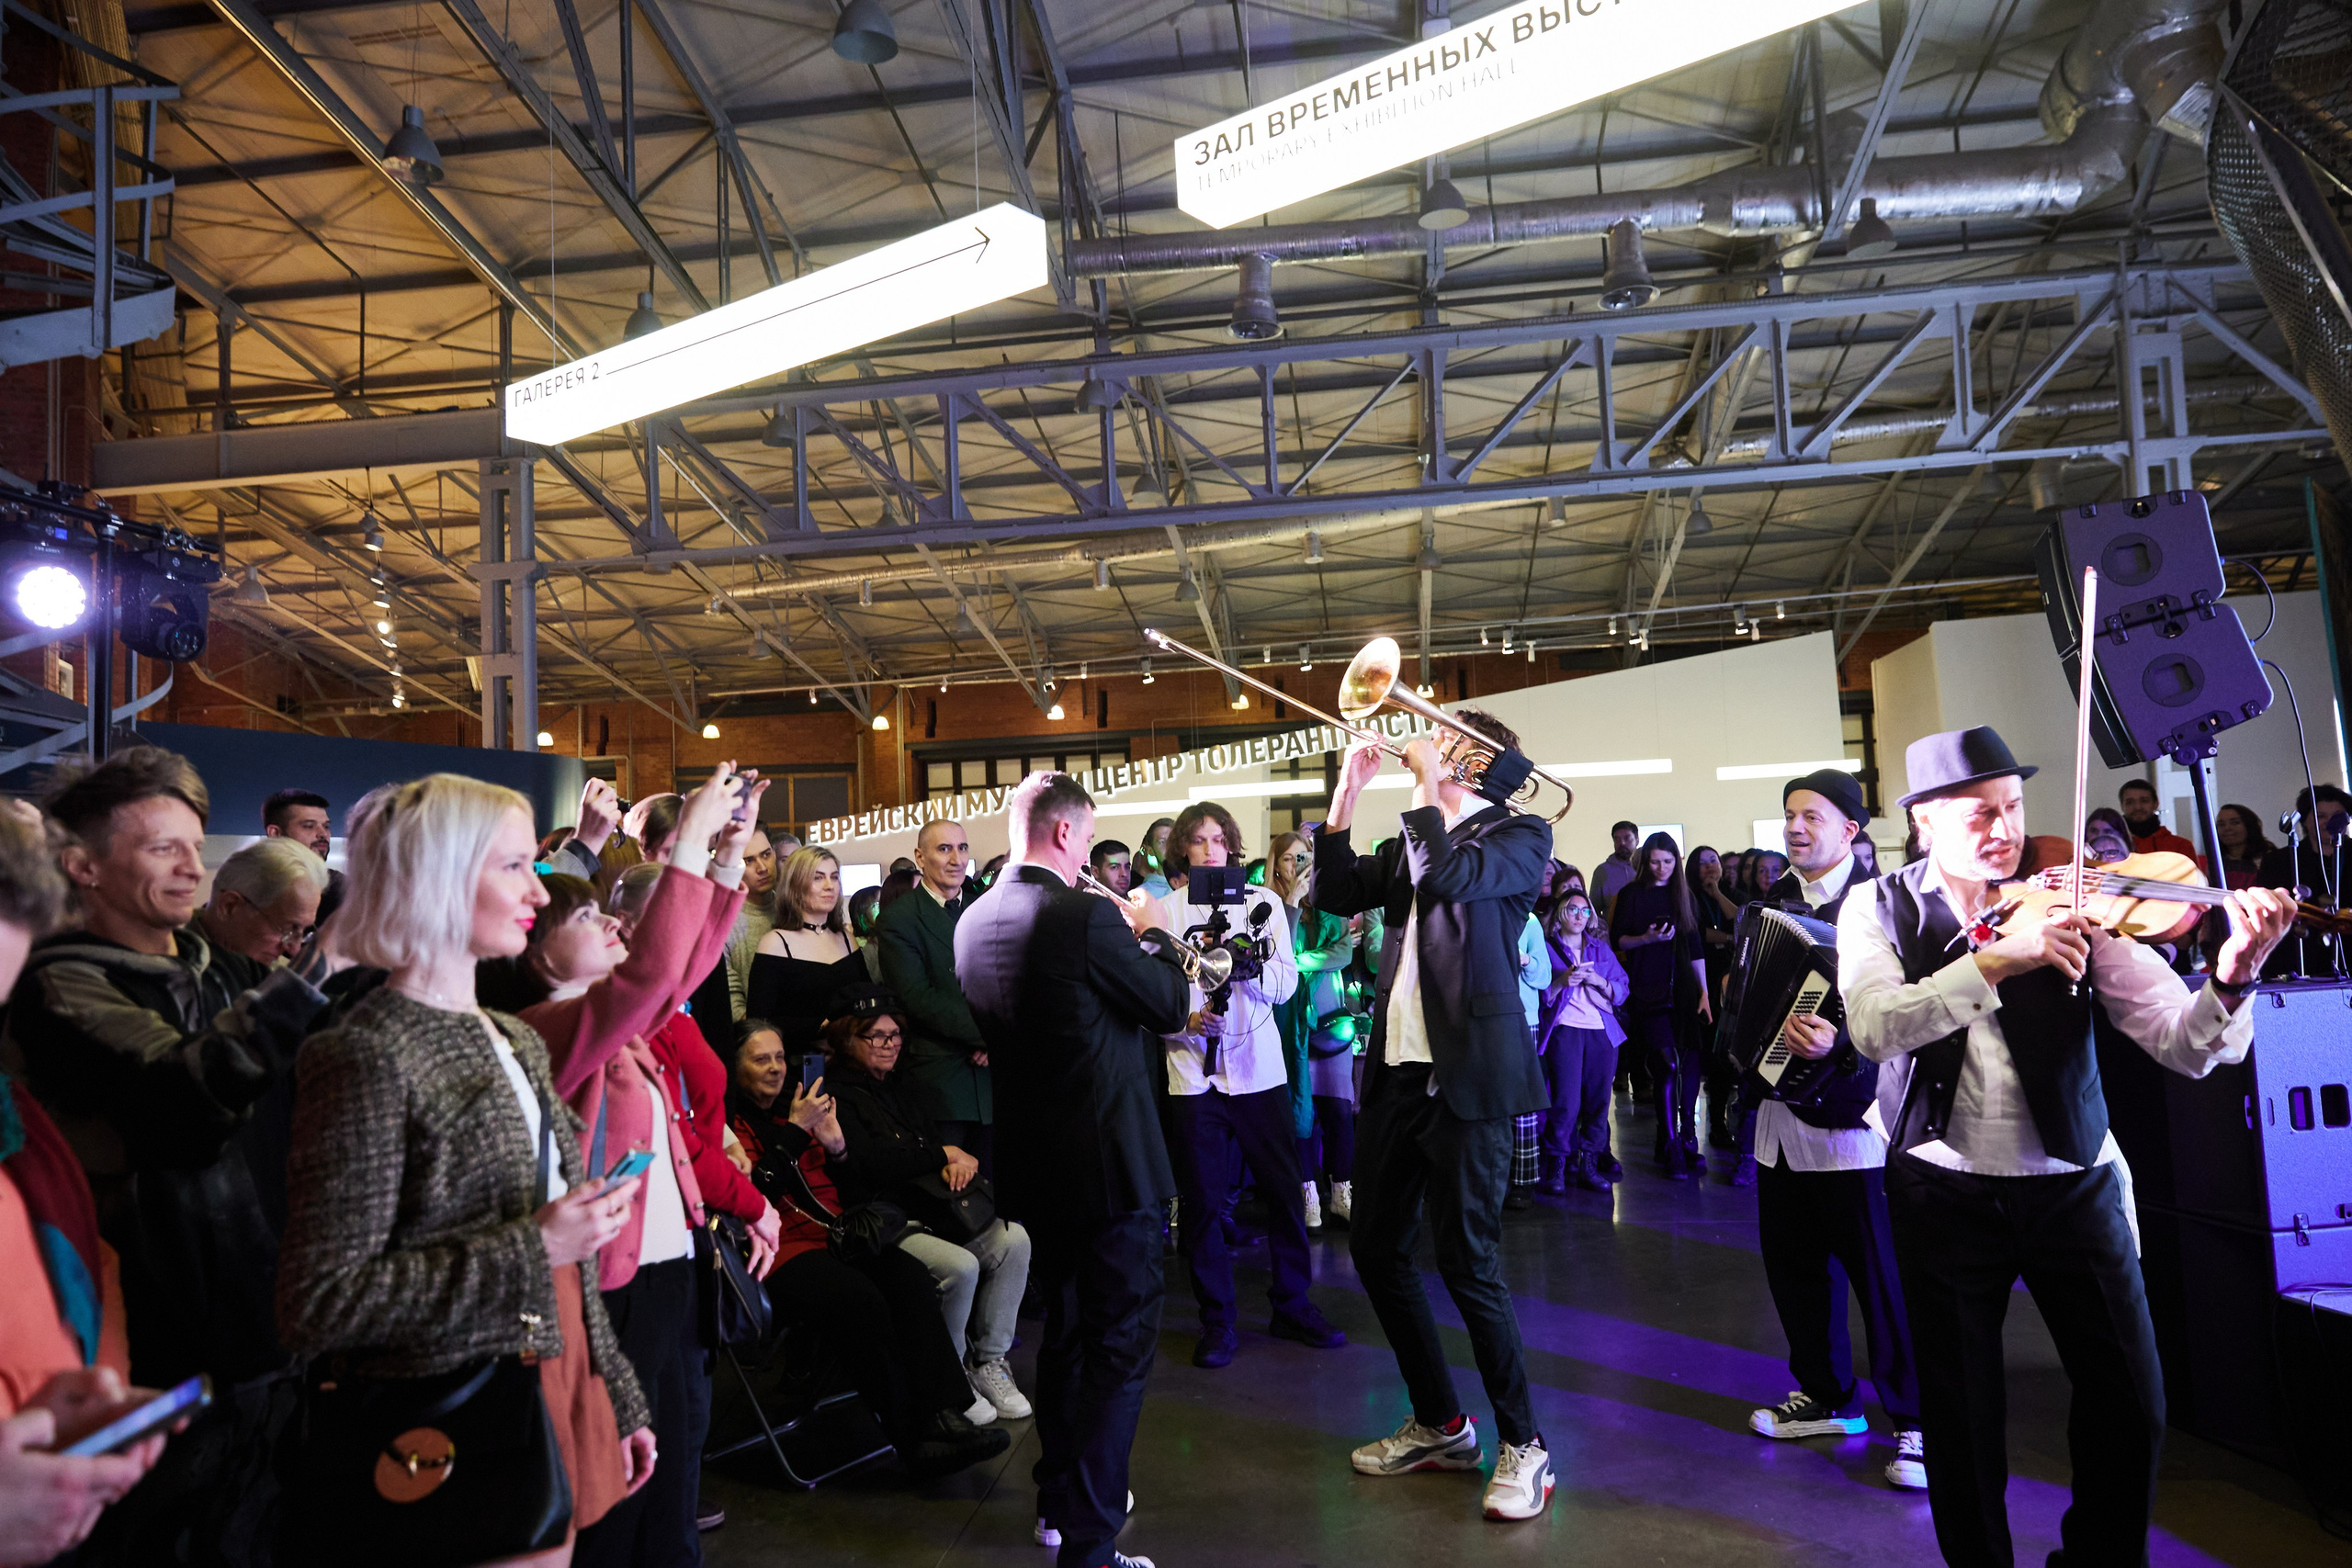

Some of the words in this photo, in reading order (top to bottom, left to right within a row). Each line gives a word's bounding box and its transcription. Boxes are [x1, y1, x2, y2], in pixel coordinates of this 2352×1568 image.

[1194, 121, 1254, 165] ЗАЛ
[1268, 26, 1498, 138] ВРЕМЕННЫХ
[1511, 0, 1621, 44] ВЫС
[1197, 134, 1319, 191] TEMPORARY
[1327, 81, 1453, 144] EXHIBITION
[1462, 57, 1522, 93] HALL
[514, 367, 585, 408] ГАЛЕРЕЯ
[592, 361, 600, 381] 2
[805, 792, 964, 847] ЕВРЕЙСКИЙ
[1092, 752, 1187, 796] ЦЕНТР
